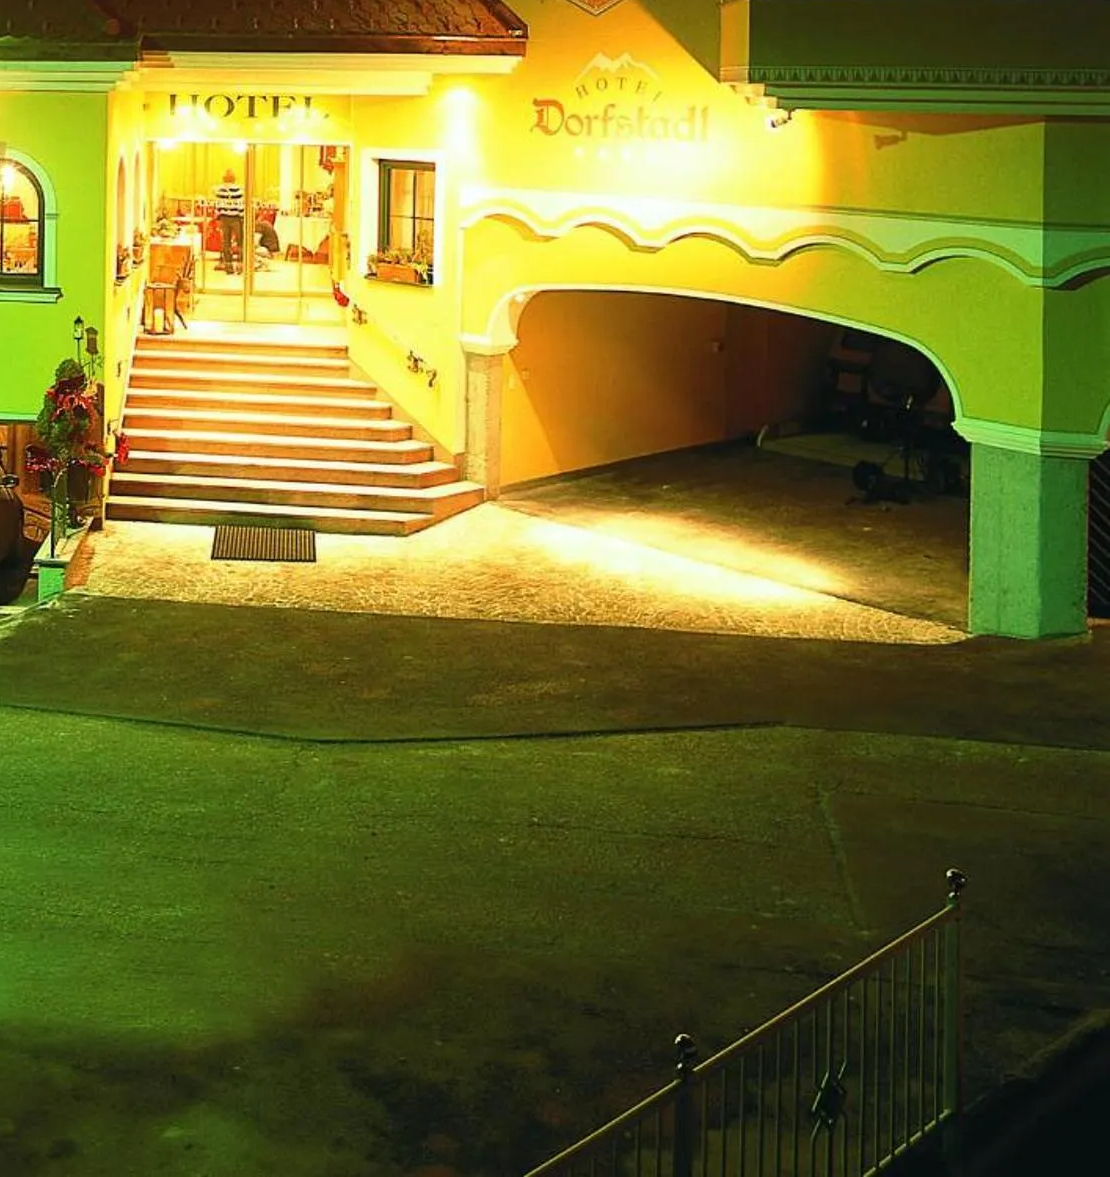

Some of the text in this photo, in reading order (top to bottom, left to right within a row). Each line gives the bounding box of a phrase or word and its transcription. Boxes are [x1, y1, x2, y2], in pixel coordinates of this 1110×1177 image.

[575, 76, 663, 103] HOTEL
[168, 93, 330, 121] HOTEL
[529, 97, 710, 142] Dorfstadl
